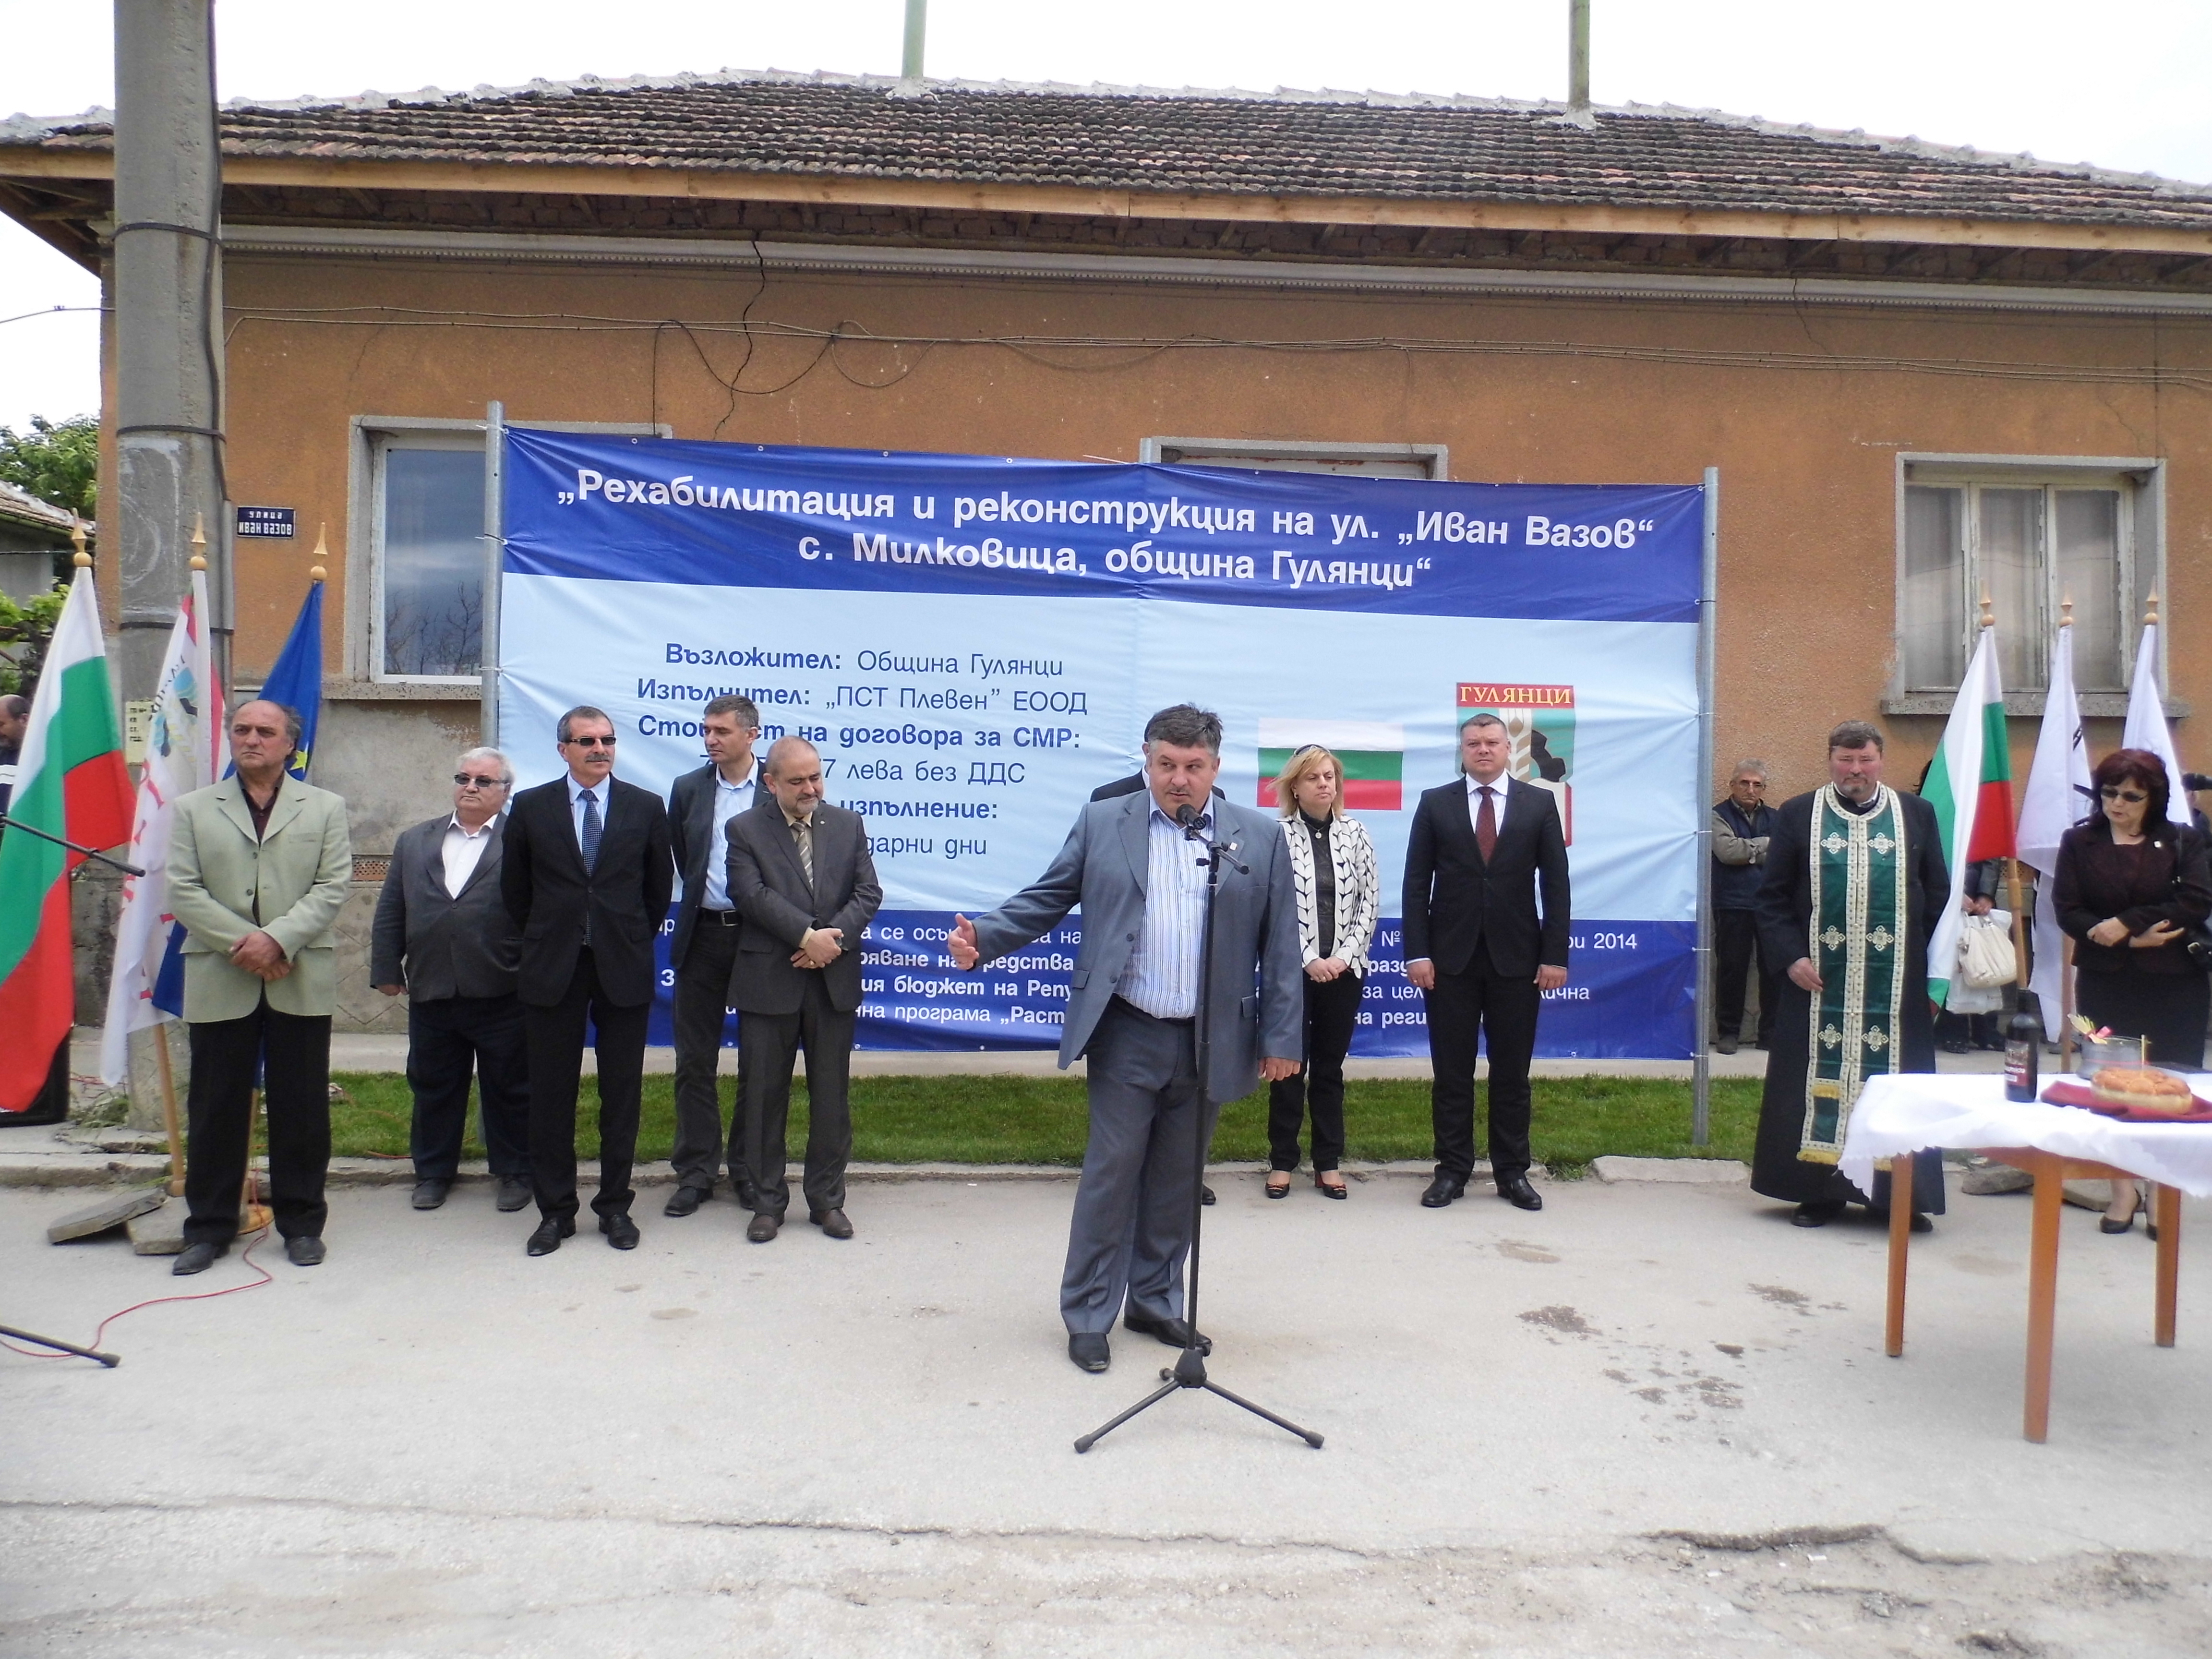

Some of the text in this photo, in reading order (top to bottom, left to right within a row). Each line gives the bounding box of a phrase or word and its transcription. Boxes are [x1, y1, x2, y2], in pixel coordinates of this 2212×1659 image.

[558, 469, 1654, 549] „Рехабилитация и реконструкция на ул. „Иван Вазов“
[799, 532, 1431, 591] с. Милковица, община Гулянци“
[666, 643, 1063, 679] Възложител: Община Гулянци
[826, 686, 889, 709] „ПСТ
[900, 688, 1000, 710] Плевен”
[1014, 691, 1087, 715] ЕООД
[1460, 686, 1571, 706] ГУЛЯНЦИ
[798, 726, 827, 742] на
[840, 724, 962, 750] договора
[974, 731, 1001, 746] за
[1013, 727, 1080, 748] СМР:
[847, 759, 903, 781] лева
[915, 760, 957, 781] без
[968, 762, 1025, 786] ДДС
[945, 839, 986, 859] дни
[880, 927, 904, 940] се
[1593, 933, 1637, 949] 2014
[894, 975, 984, 998] бюджет
[994, 983, 1018, 996] на
[1027, 980, 1071, 1002] Репу
[1362, 986, 1383, 999] за
[1392, 986, 1424, 1001] цел
[895, 1007, 990, 1024] програма
[1382, 1012, 1427, 1028] реги
